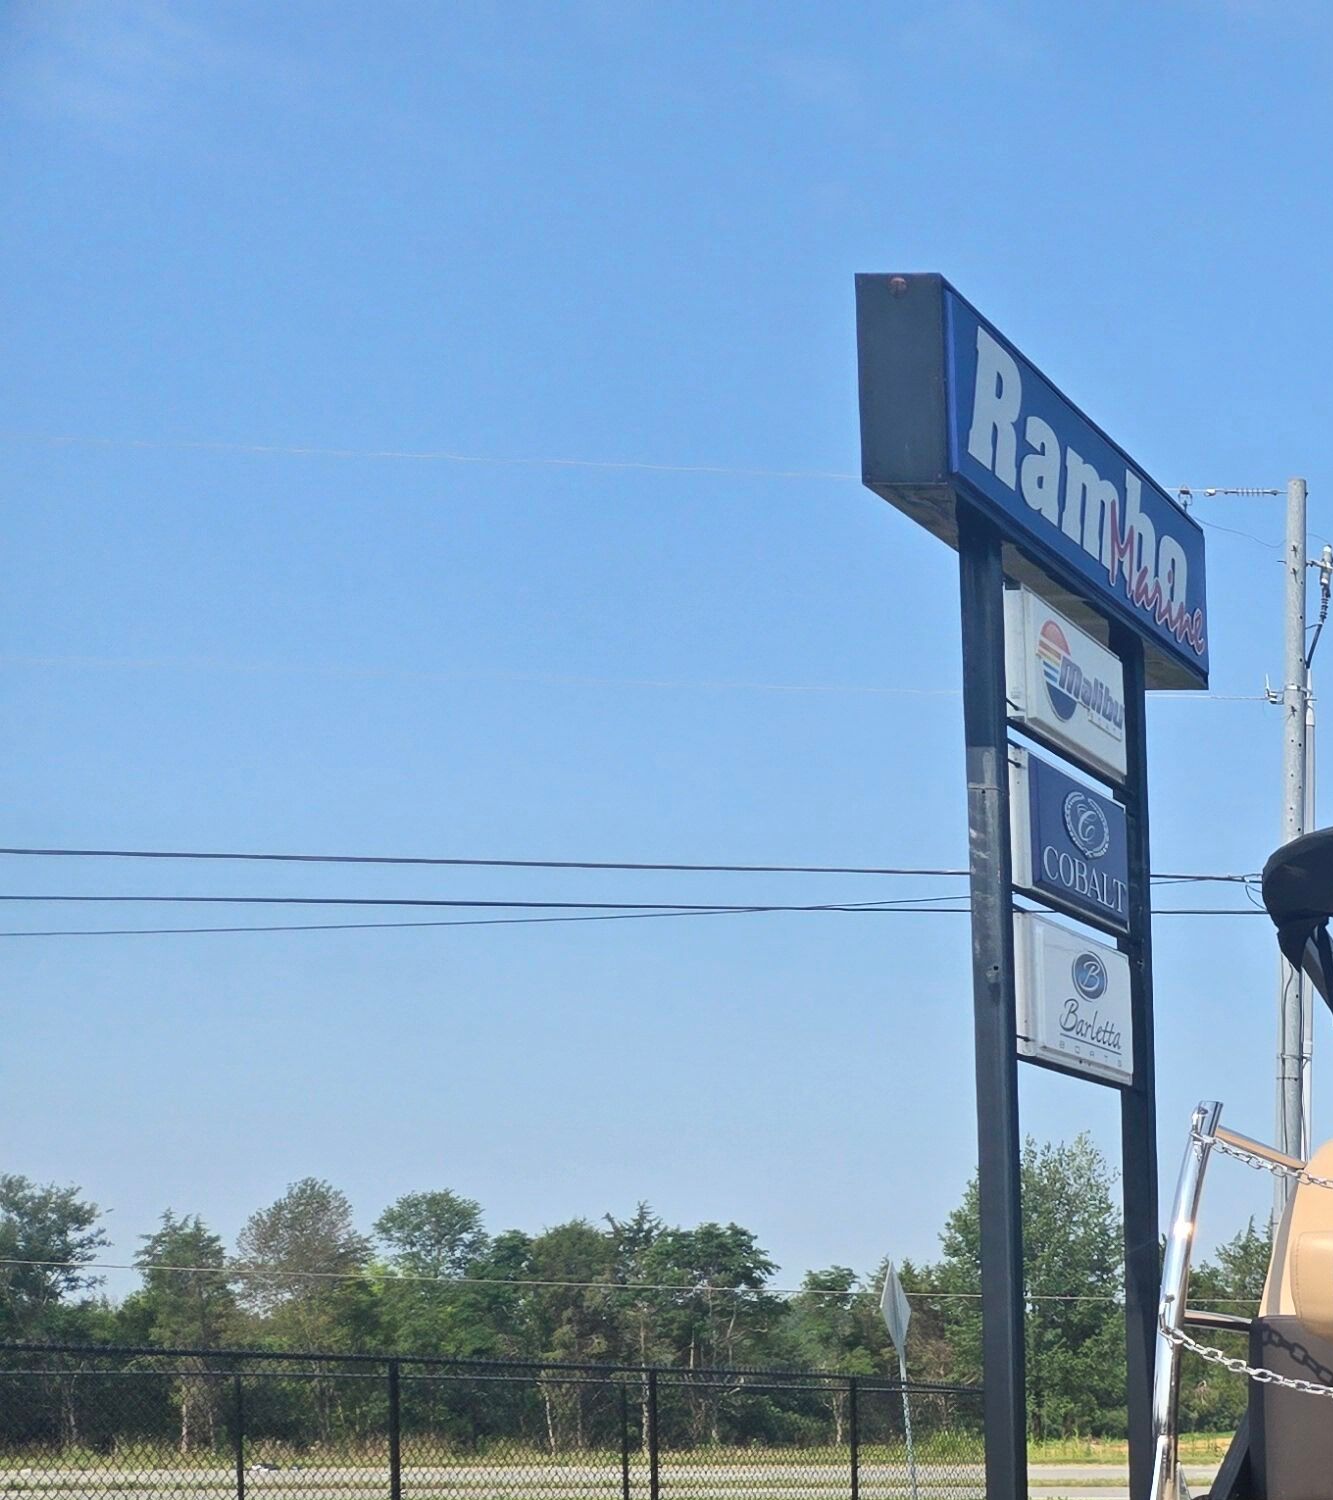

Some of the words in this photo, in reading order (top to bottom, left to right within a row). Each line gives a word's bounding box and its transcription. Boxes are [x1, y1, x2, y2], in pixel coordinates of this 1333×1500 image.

[967, 325, 1189, 613] Rambo
[1109, 498, 1205, 656] Marine
[1059, 656, 1124, 730] Malibu
[1043, 845, 1126, 913] COBALT
[1059, 998, 1121, 1050] Barletta
